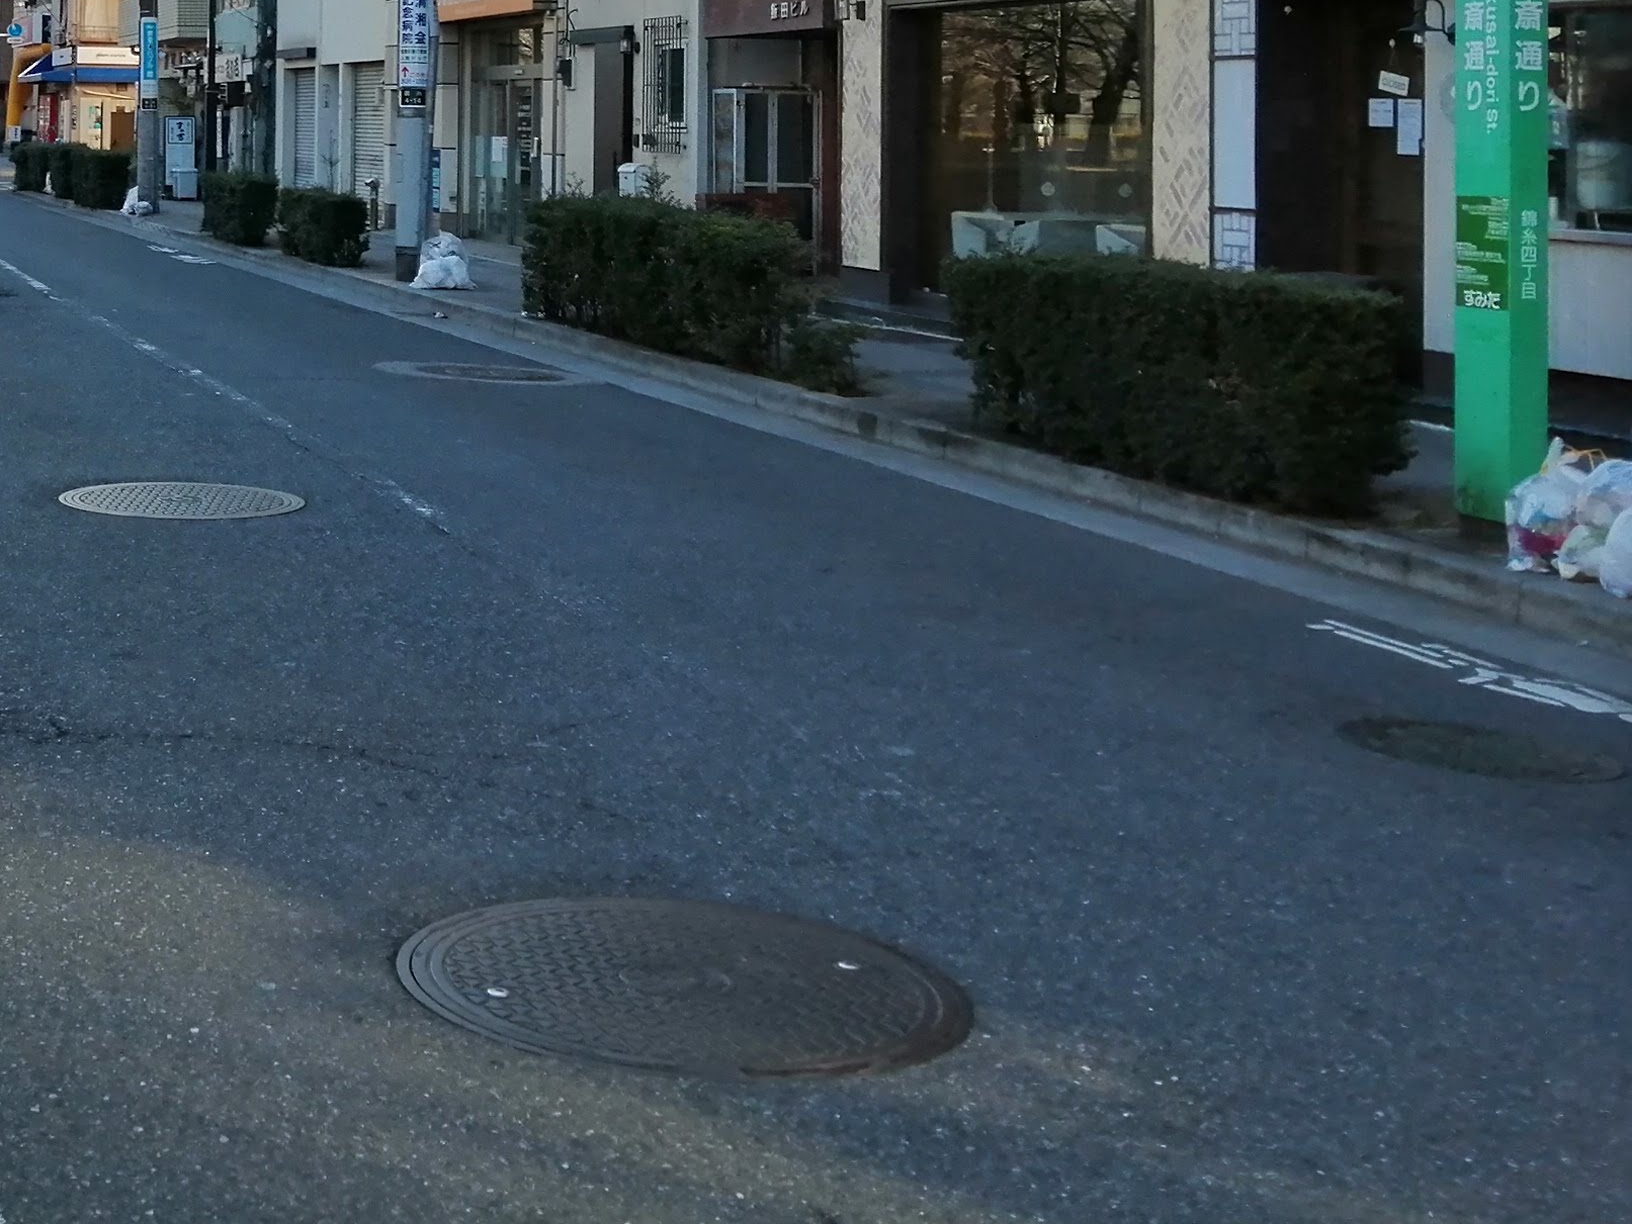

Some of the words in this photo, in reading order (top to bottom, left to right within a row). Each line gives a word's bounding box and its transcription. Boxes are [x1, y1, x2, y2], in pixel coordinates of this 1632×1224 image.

[1486, 109, 1499, 134] St.
[1521, 210, 1538, 299] 錦糸四丁目
[1463, 289, 1501, 310] すみだ
